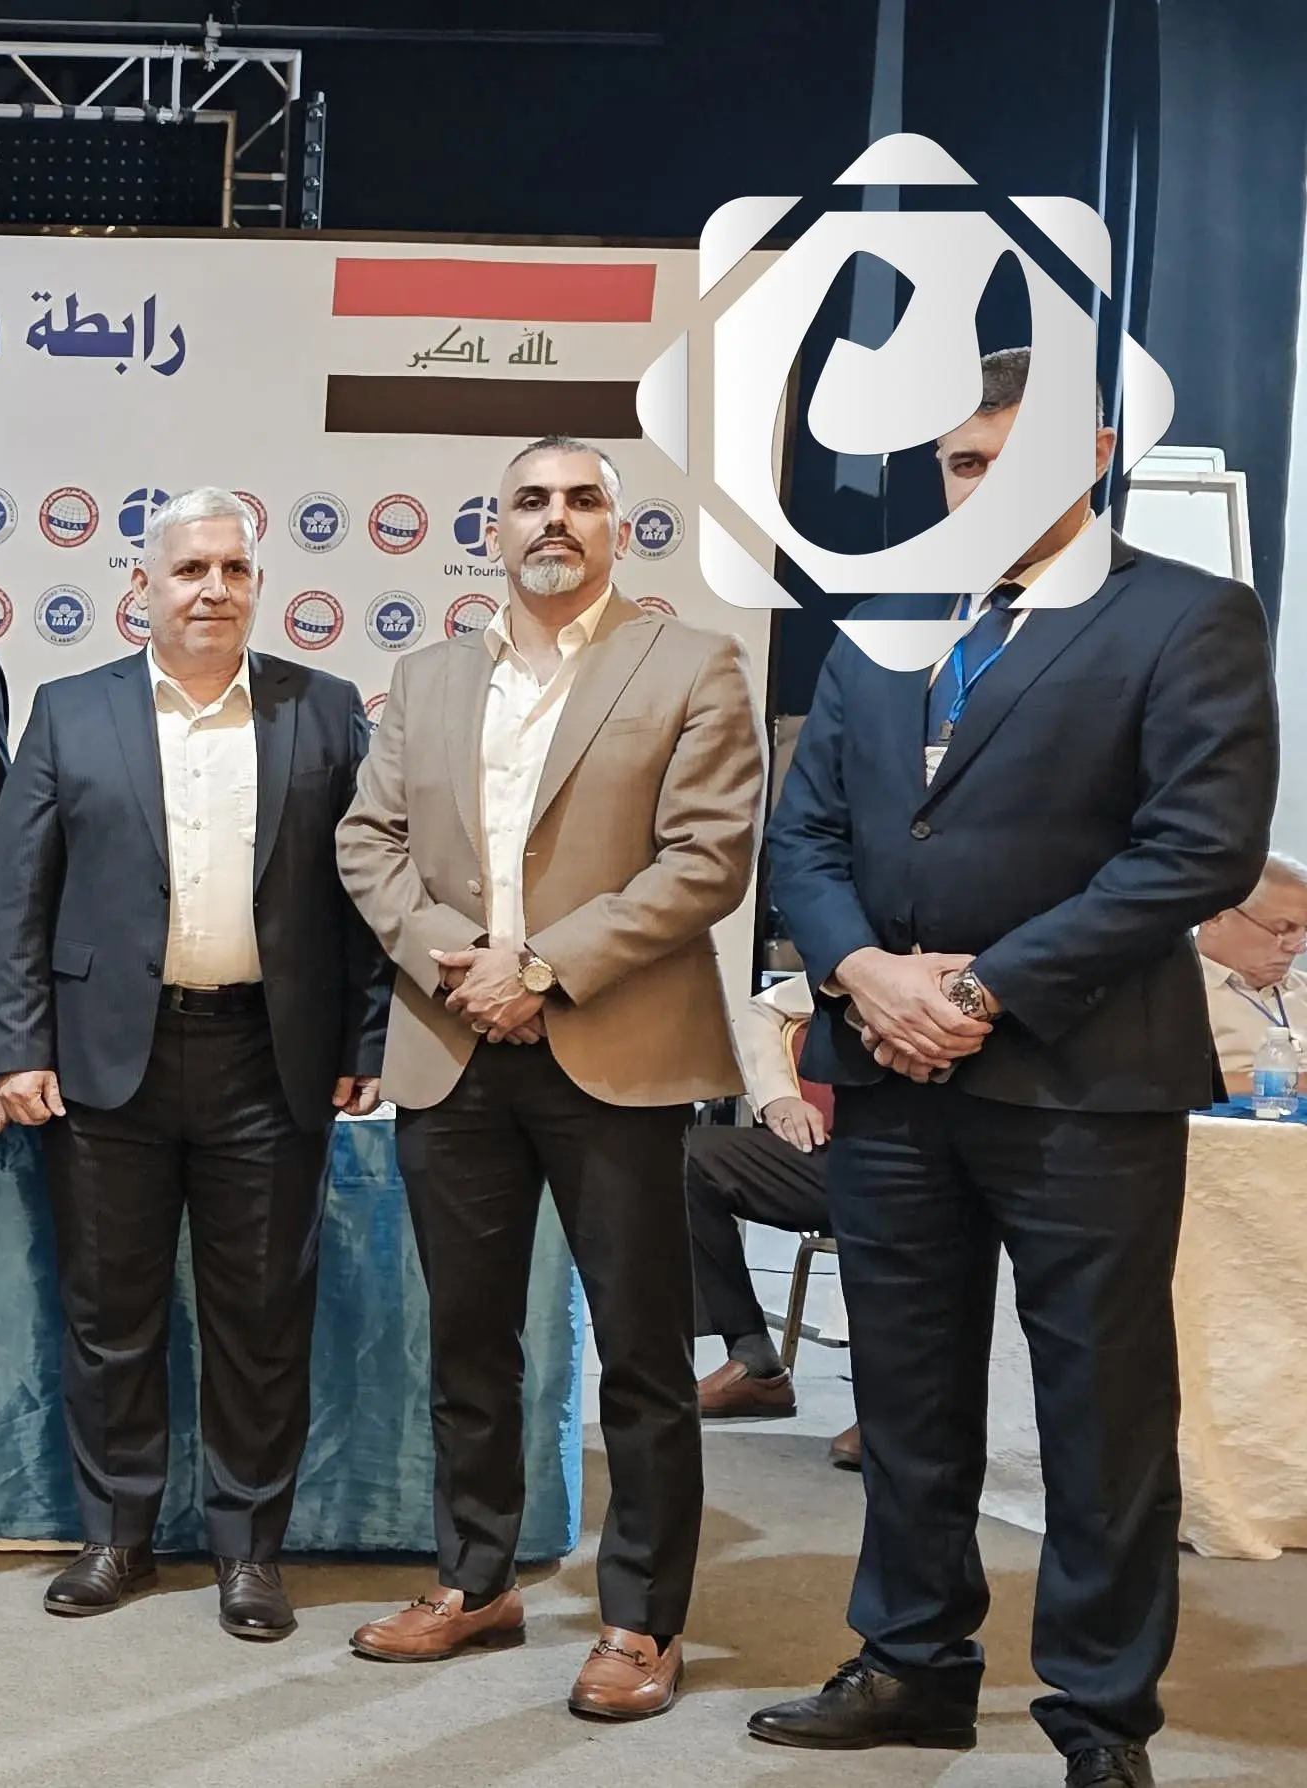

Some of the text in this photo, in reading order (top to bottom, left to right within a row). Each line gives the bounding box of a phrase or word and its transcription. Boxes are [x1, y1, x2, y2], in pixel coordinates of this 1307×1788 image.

[25, 291, 186, 377] رابطة
[306, 524, 332, 533] IATA
[641, 531, 666, 540] IATA
[109, 556, 128, 568] UN
[444, 564, 506, 577] UN Touris
[51, 617, 77, 626] IATA
[382, 623, 407, 632] IATA
